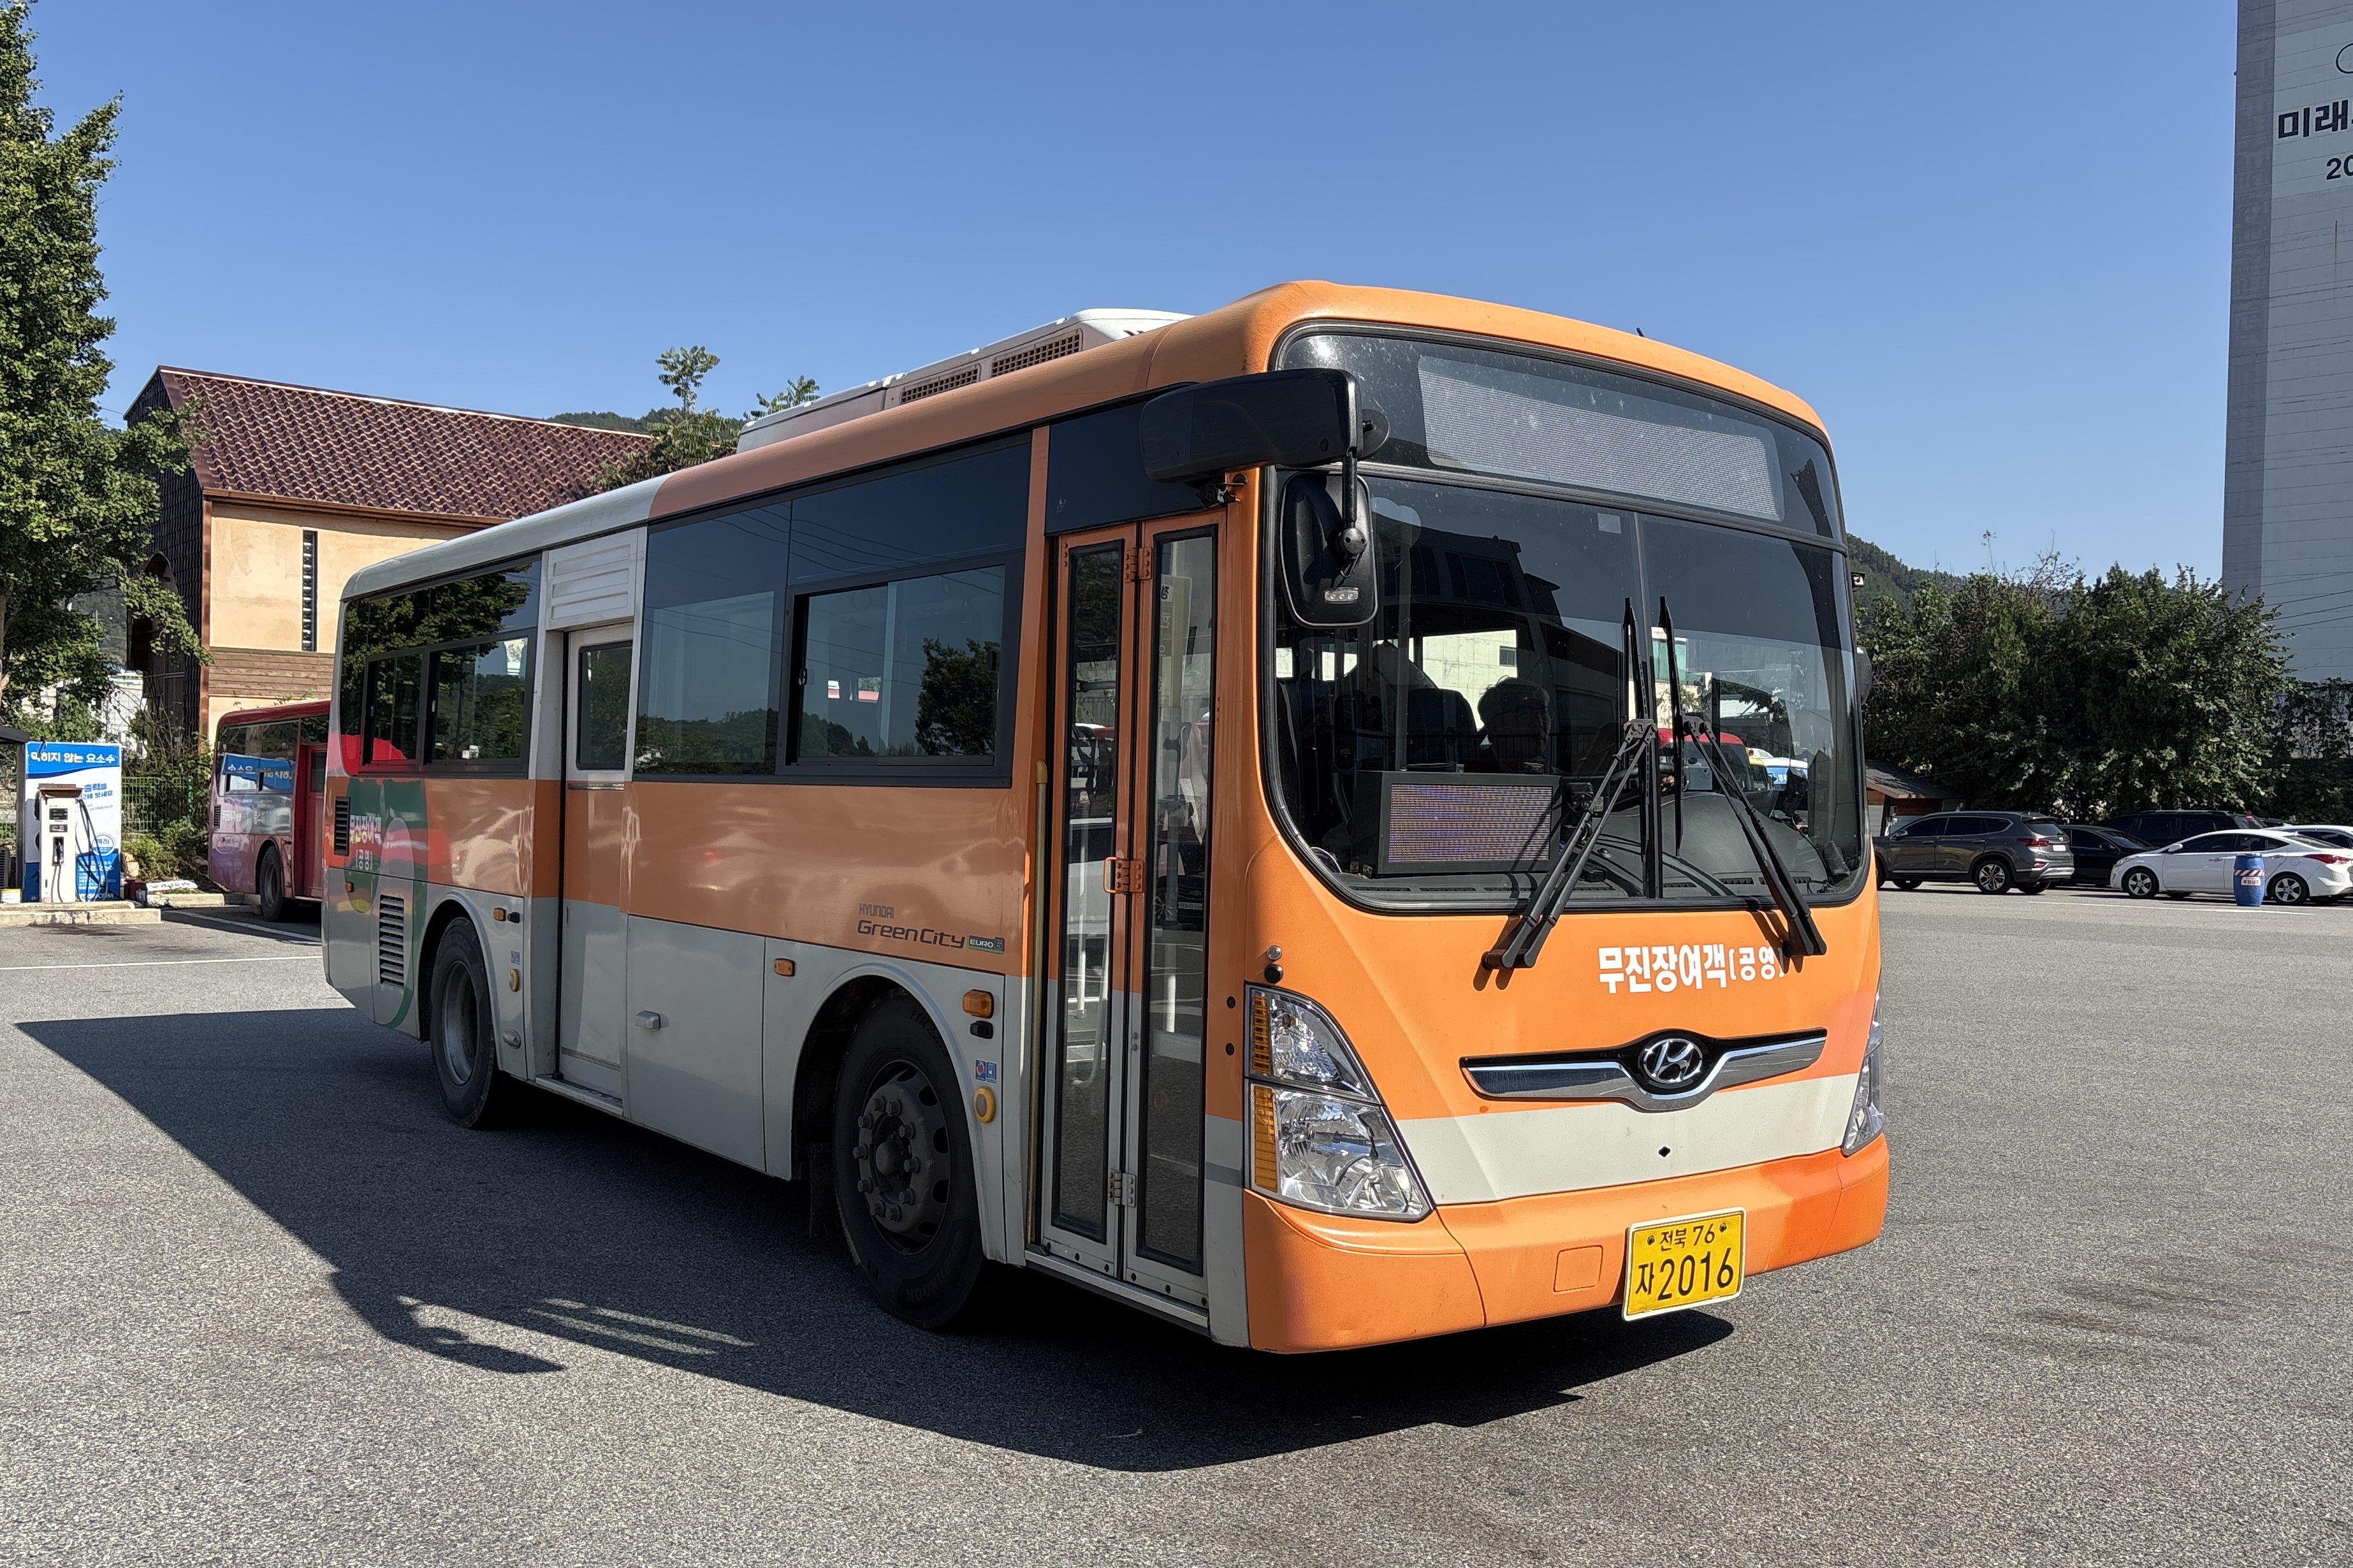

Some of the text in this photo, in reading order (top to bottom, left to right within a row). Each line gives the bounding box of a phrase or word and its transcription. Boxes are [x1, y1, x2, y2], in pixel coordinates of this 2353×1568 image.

[2278, 99, 2353, 139] 미래
[86, 753, 116, 764] 요소수
[349, 815, 381, 845] 무진장여객
[859, 903, 894, 919] HYUNDAI
